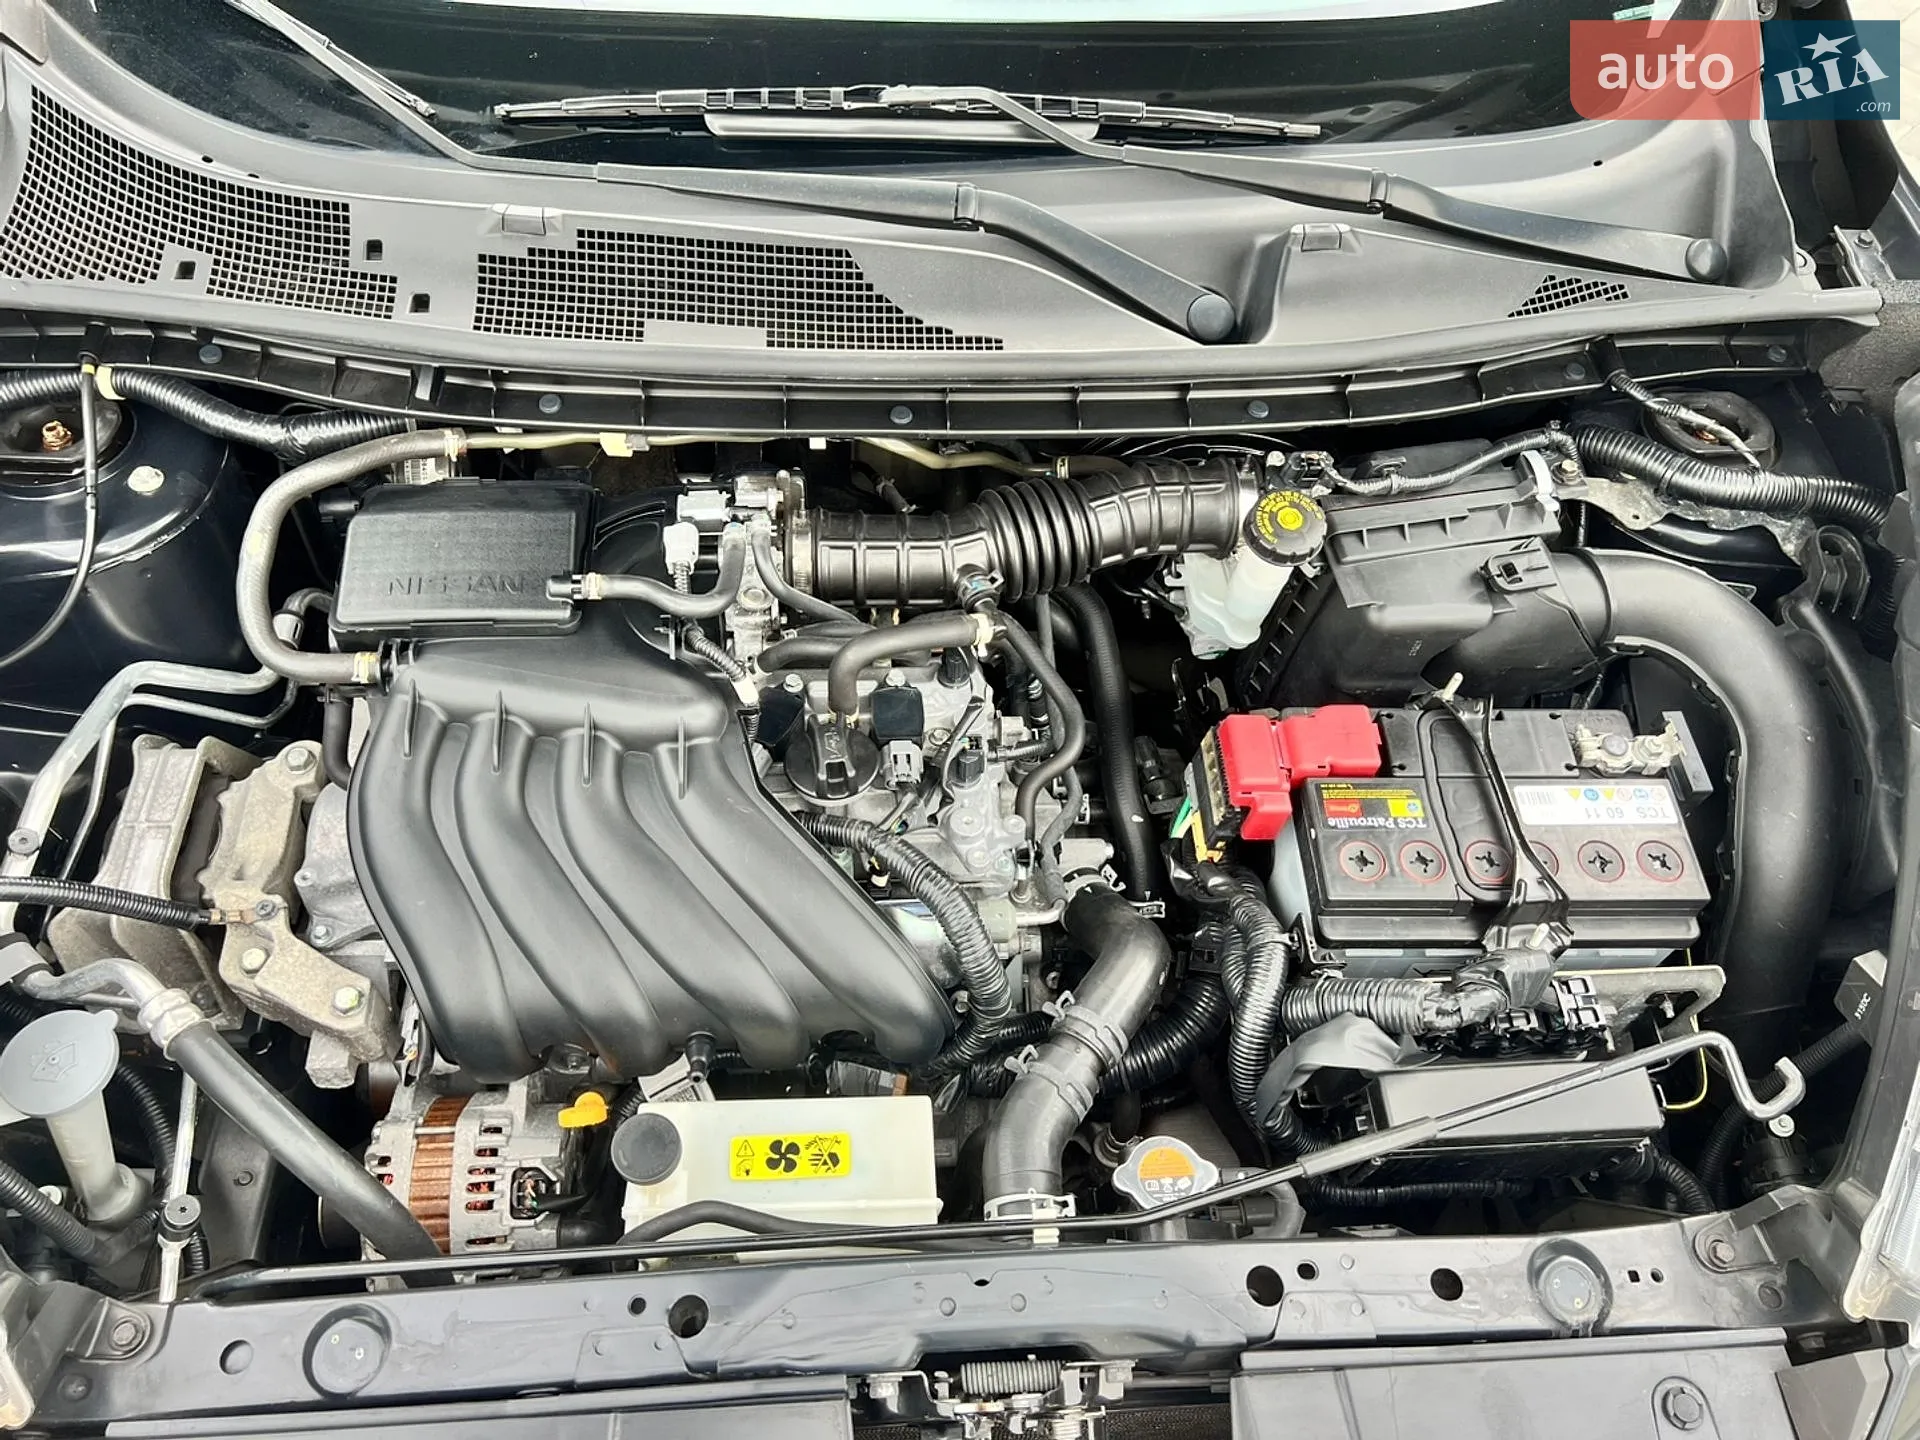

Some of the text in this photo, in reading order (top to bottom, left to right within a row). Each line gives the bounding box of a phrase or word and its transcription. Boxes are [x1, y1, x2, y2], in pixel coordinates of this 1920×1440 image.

[388, 575, 524, 595] NISSAN
[1635, 806, 1670, 819] TCS
[1327, 816, 1427, 829] TCS Patrouille
